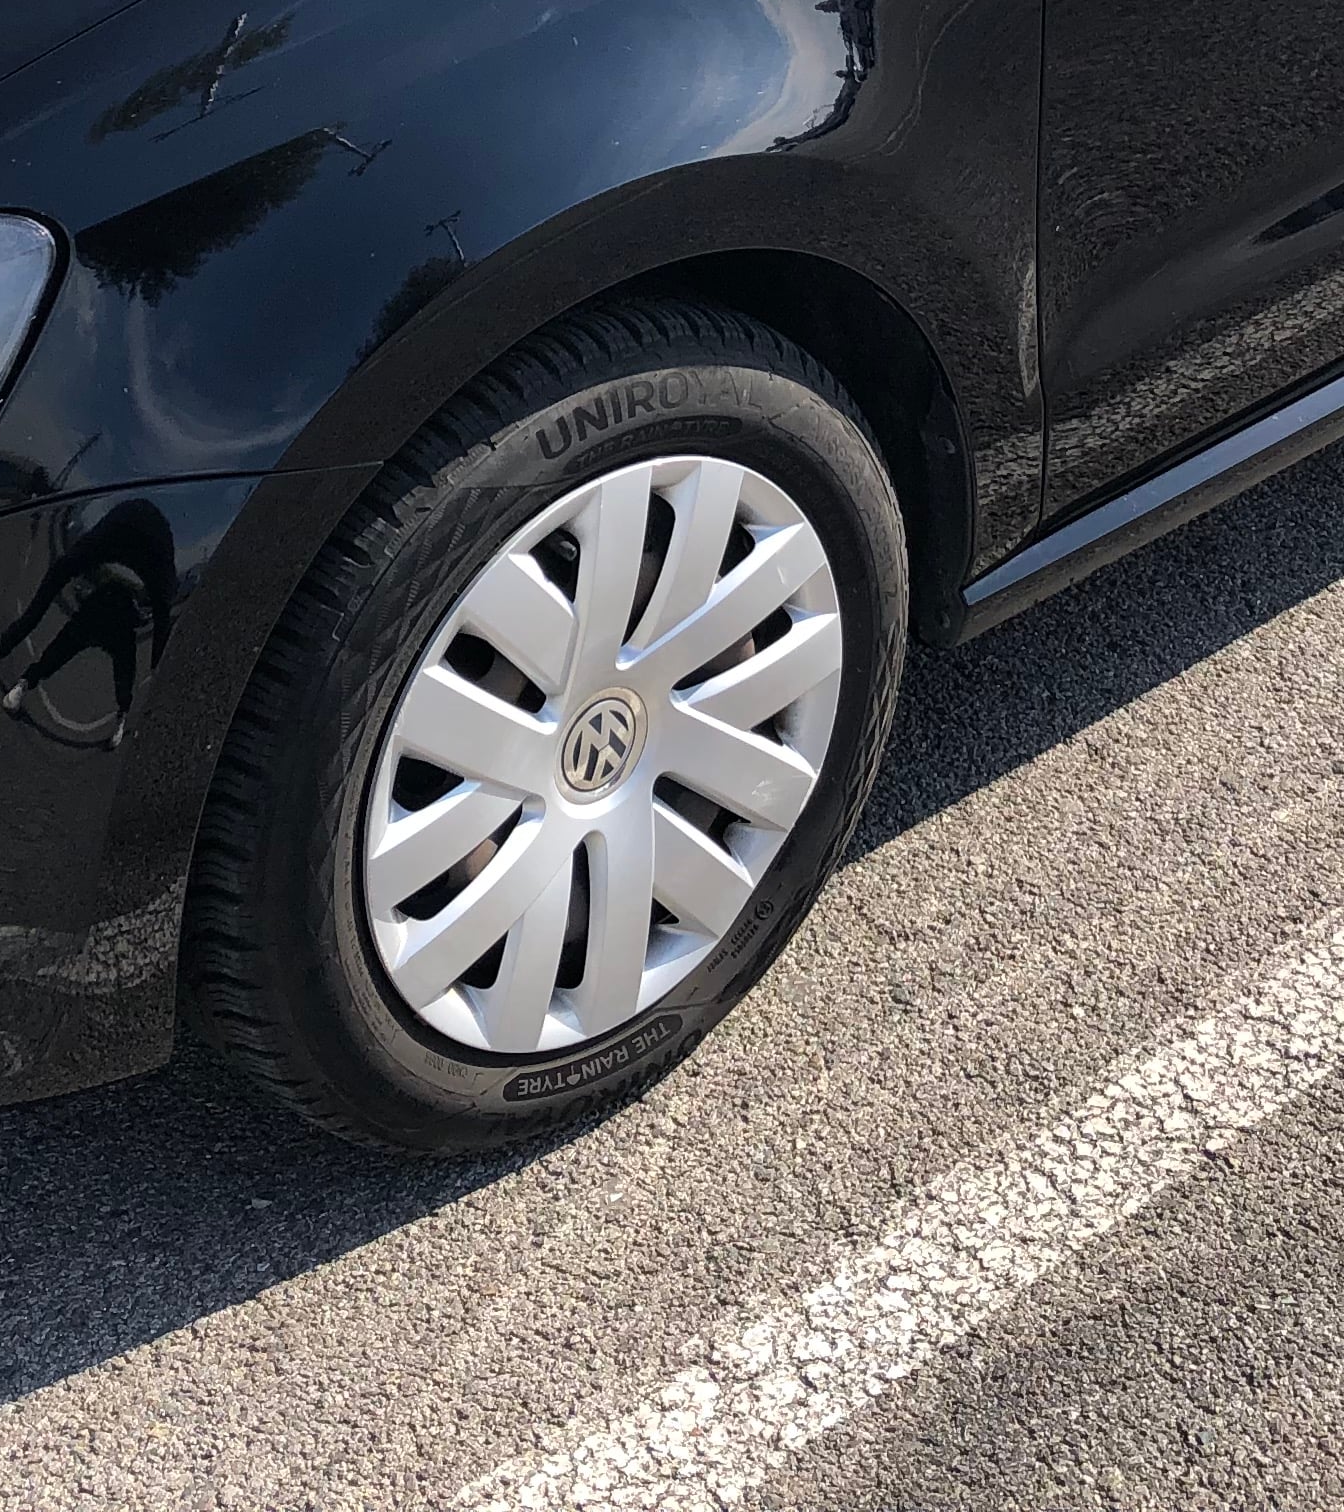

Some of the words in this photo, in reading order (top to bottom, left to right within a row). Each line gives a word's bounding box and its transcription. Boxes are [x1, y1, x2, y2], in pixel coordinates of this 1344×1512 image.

[536, 371, 762, 460] UNIROYAL
[632, 1023, 670, 1053] THE
[581, 1052, 629, 1081] RAIN
[517, 1073, 566, 1096] TYRE
